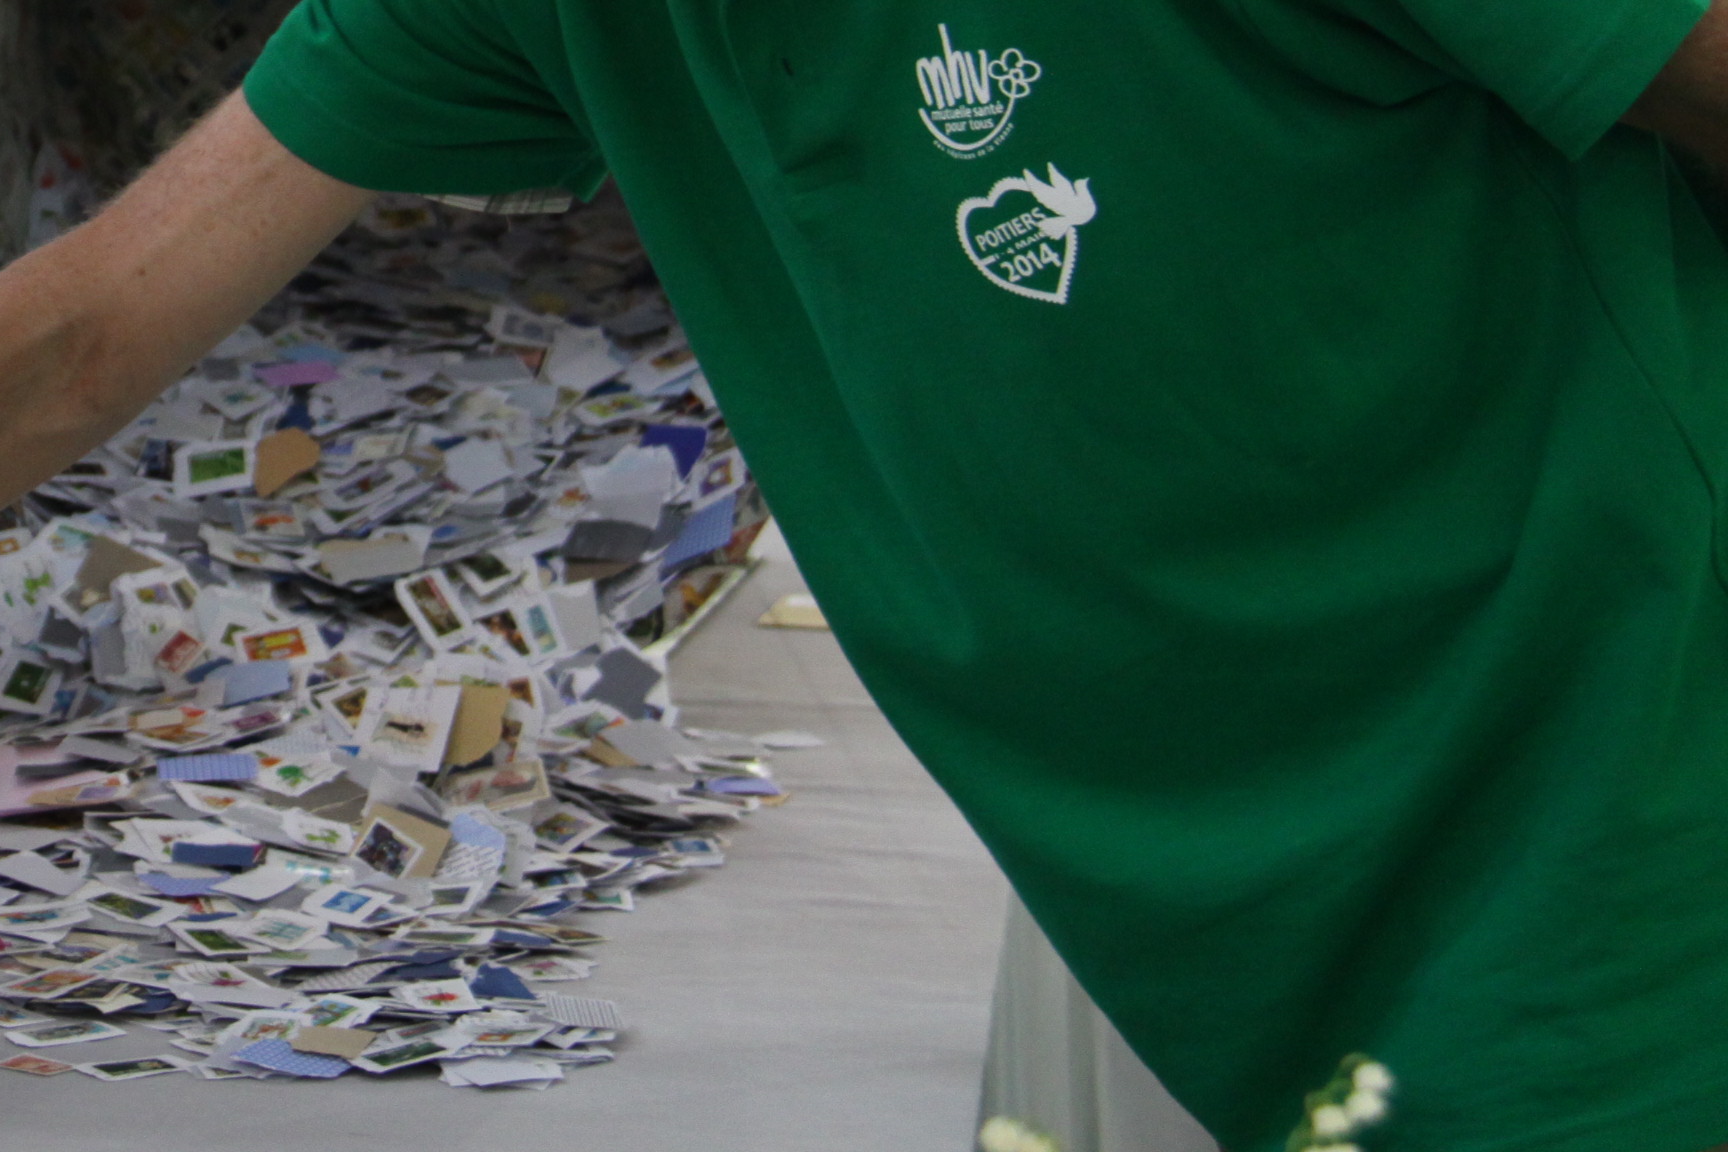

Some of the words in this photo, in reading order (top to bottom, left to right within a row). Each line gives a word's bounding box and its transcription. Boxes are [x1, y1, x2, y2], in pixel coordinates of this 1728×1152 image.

[931, 105, 972, 121] mutuelle
[973, 100, 1004, 117] santé
[945, 121, 967, 136] pour
[969, 117, 994, 131] tous
[975, 207, 1046, 252] POITIERS
[1000, 242, 1062, 282] 2014
